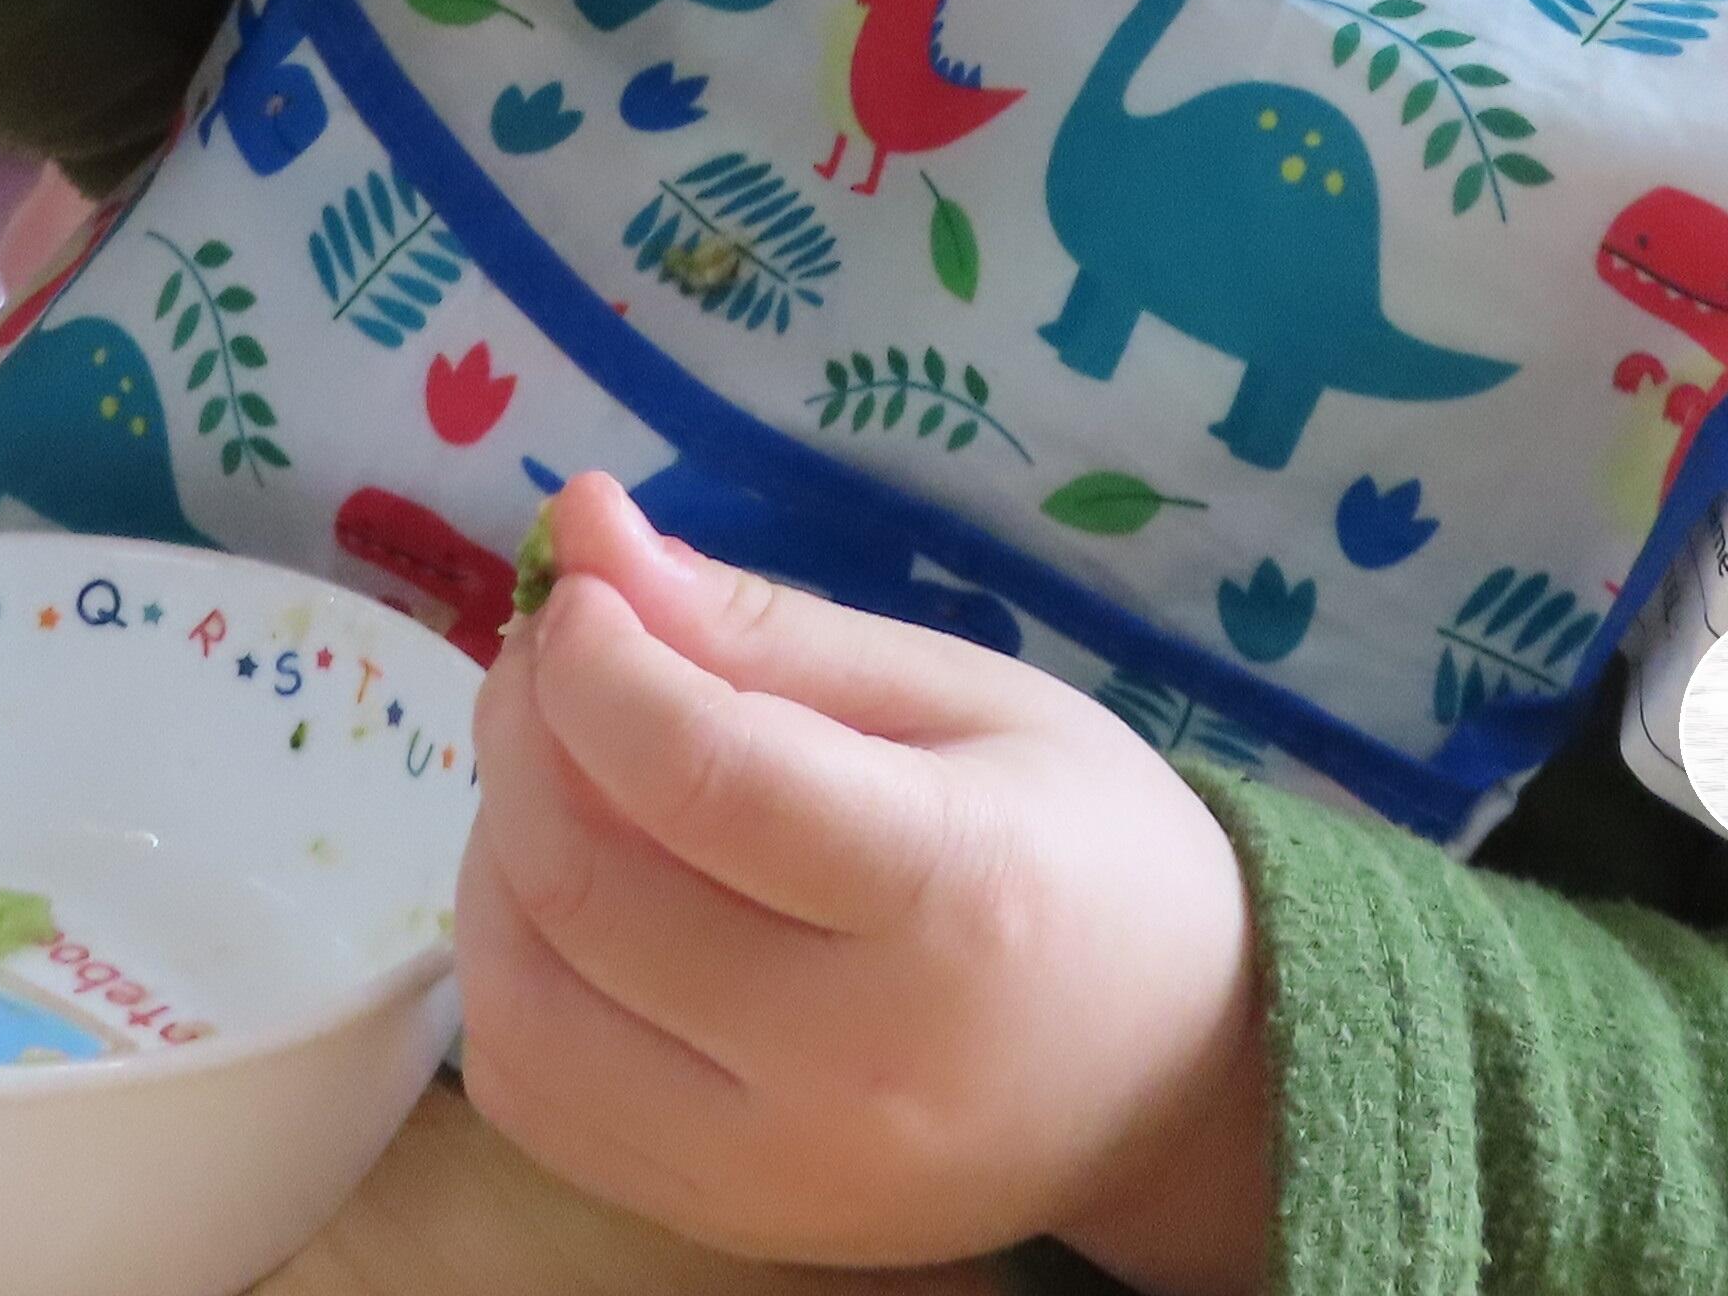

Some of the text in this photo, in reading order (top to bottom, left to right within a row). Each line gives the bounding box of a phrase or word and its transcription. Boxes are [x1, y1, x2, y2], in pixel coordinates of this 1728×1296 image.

[76, 577, 128, 628] Q
[187, 608, 228, 658] R
[273, 650, 304, 697] S
[356, 657, 384, 705] T
[406, 728, 435, 779] U
